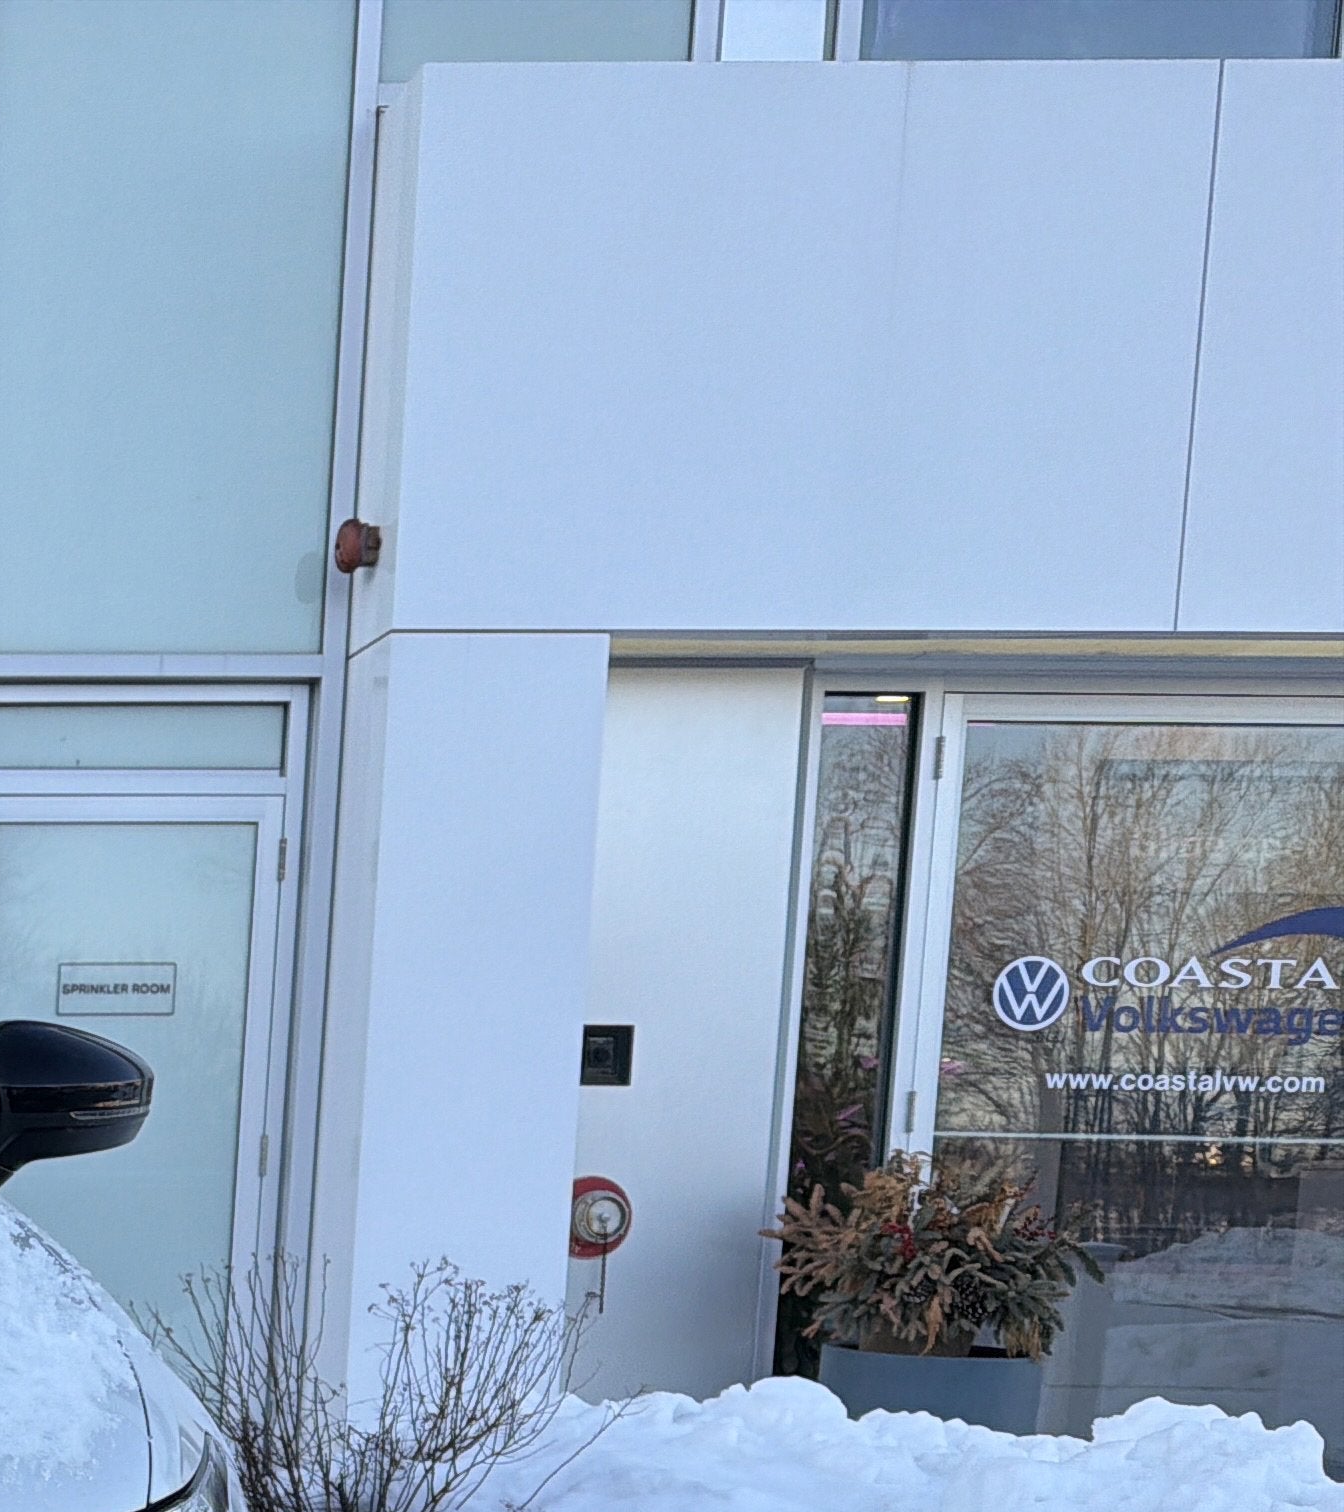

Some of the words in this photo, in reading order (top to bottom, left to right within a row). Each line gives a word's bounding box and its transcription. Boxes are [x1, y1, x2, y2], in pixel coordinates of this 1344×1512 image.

[62, 983, 129, 995] SPRINKLER
[131, 983, 171, 995] ROOM
[1081, 955, 1344, 990] COASTA
[994, 956, 1069, 1030] VW
[1080, 995, 1344, 1046] Volkswage
[1045, 1069, 1326, 1094] www.coastalvw.com
